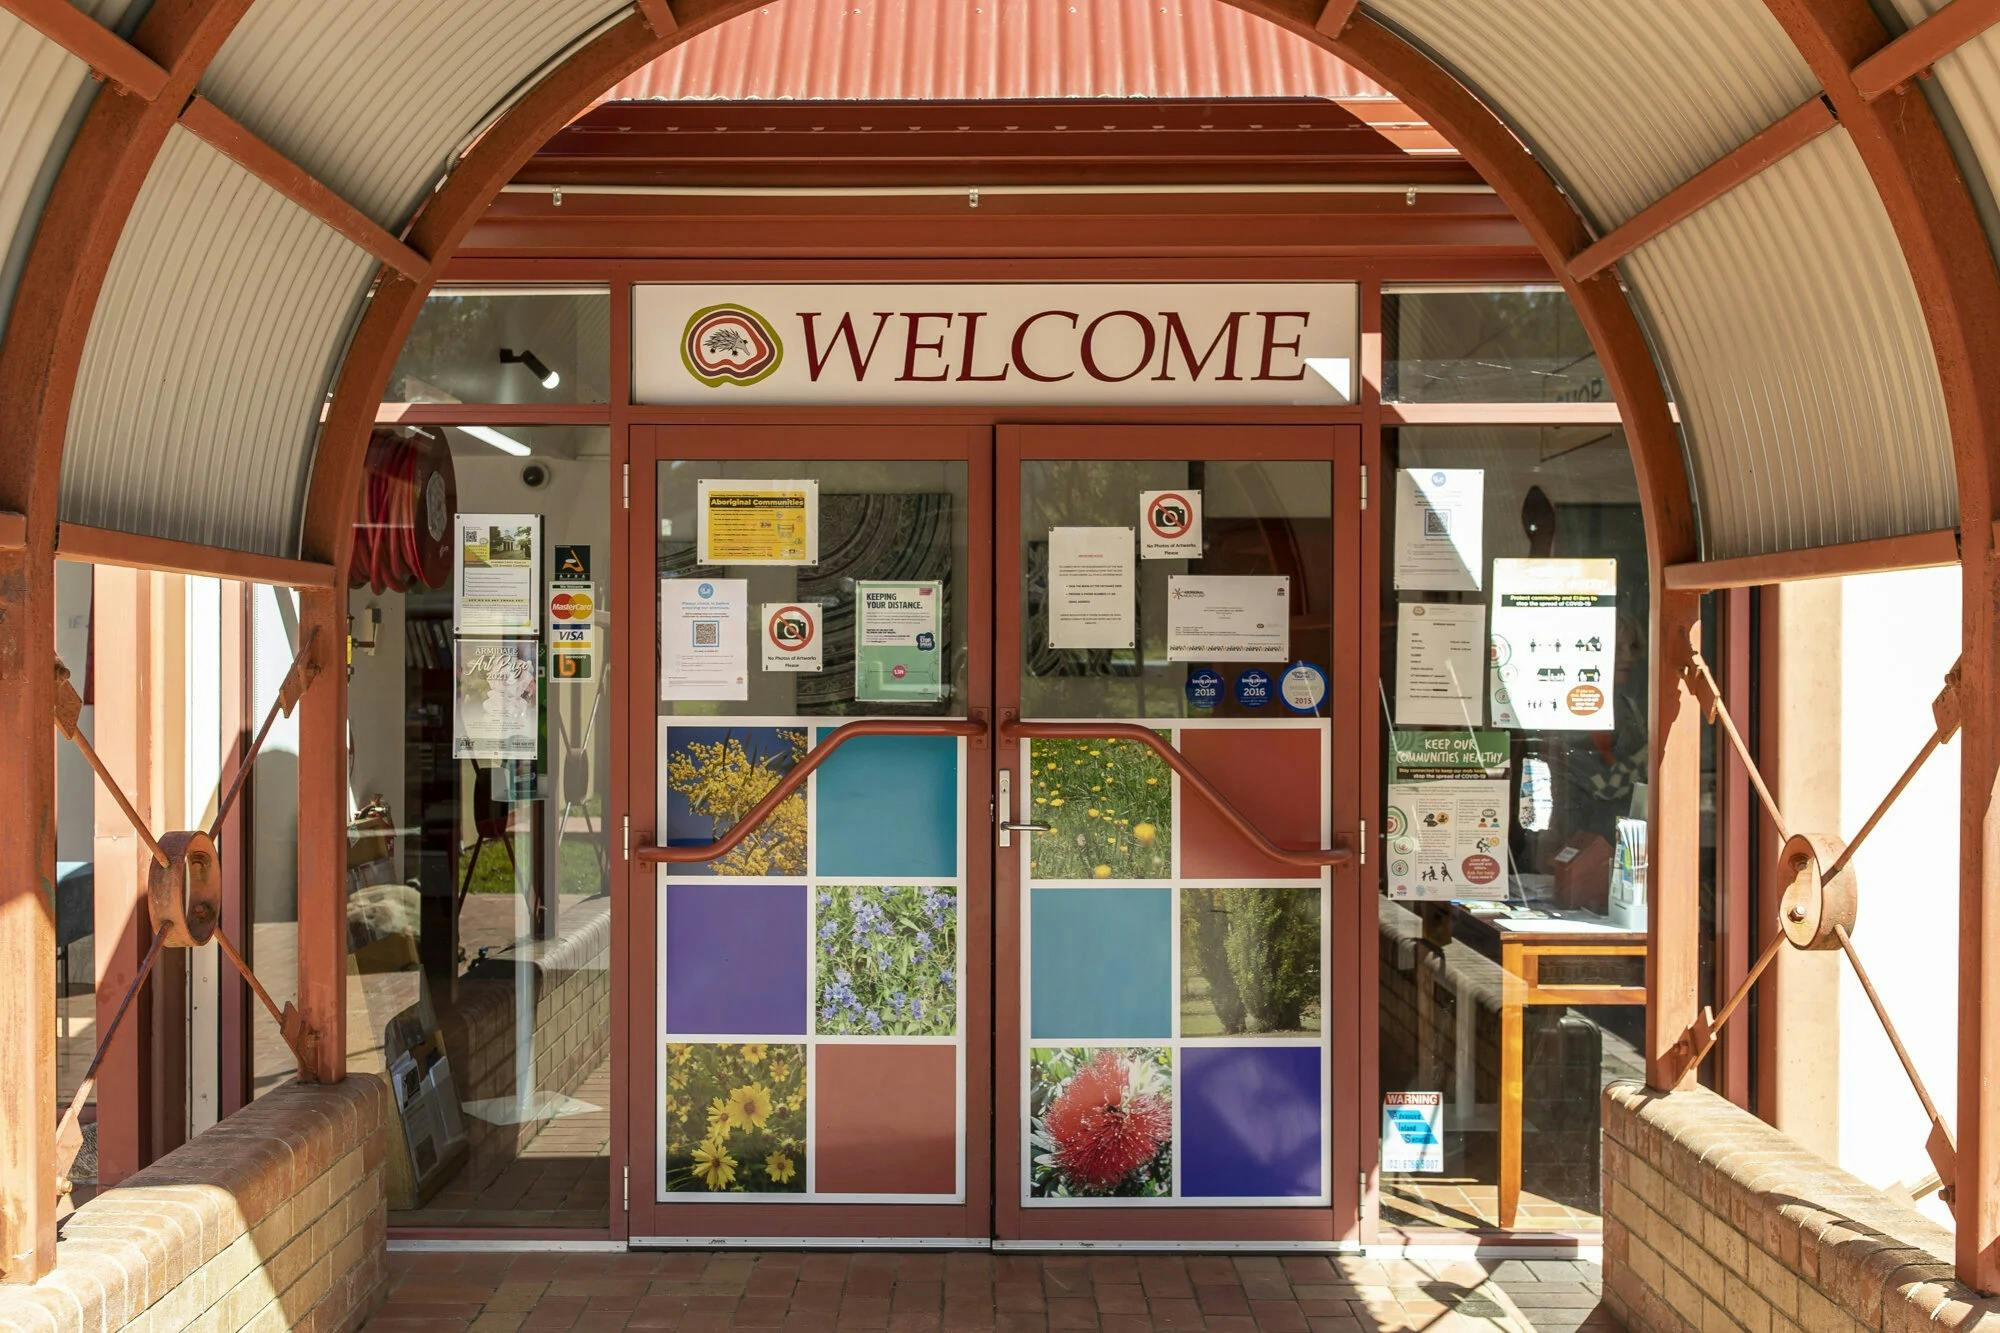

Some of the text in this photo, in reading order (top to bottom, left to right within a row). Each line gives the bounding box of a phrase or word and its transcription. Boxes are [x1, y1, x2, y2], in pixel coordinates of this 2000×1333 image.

[796, 310, 1310, 382] WELCOME
[710, 498, 804, 507] Aboriginal Communities
[552, 603, 592, 611] MasterCard
[866, 601, 923, 609] YOUR DISTANCE.
[559, 631, 584, 640] VISA
[475, 647, 519, 655] ARMIDALE
[464, 654, 529, 680] Art Prize
[1194, 688, 1216, 697] 2018
[1243, 687, 1266, 696] 2016
[1295, 697, 1312, 705] 2015
[1424, 738, 1477, 750] KEEP OUR
[1395, 751, 1503, 764] COMMUNITIES HEALTHY
[1387, 1094, 1438, 1105] WARNING
